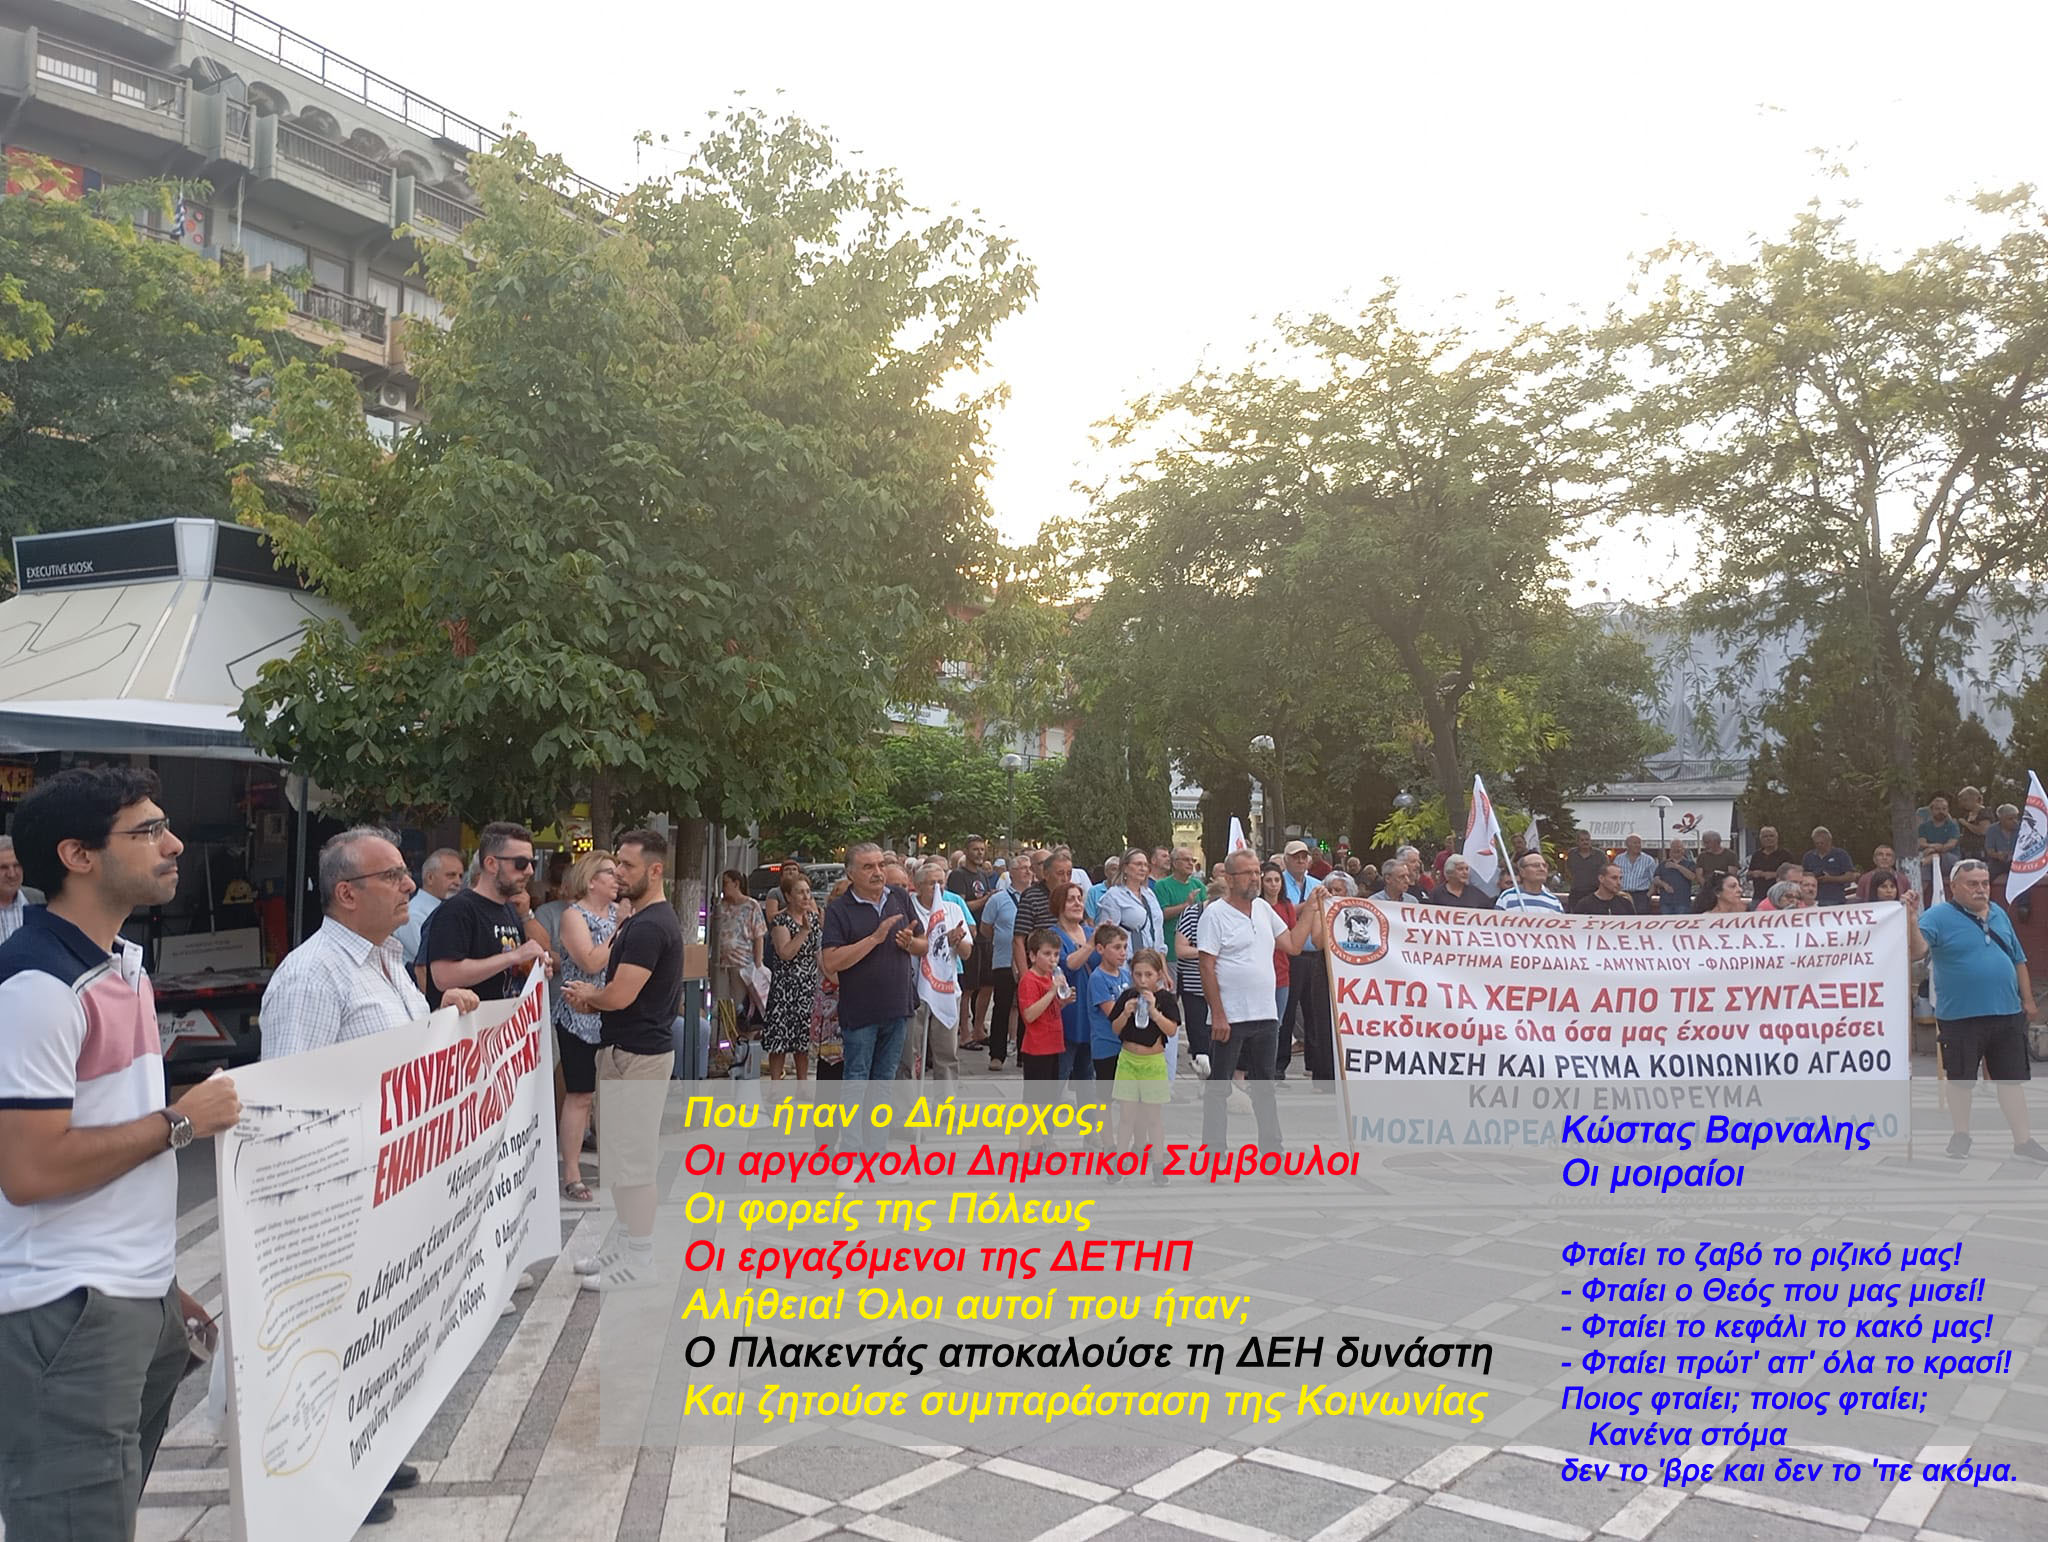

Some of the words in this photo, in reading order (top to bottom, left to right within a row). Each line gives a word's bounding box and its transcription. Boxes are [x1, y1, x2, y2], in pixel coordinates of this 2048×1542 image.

[26, 563, 68, 578] EXECUTIVE
[68, 560, 94, 574] KIOSK
[1589, 821, 1635, 835] TRENDY'S
[1401, 906, 1577, 930] ΠΑΝΕΛΛΗΝΙΟΣ
[1584, 917, 1706, 931] ΣΥΛΛΟΓΟΣ
[1708, 909, 1877, 930] ΑΛΛΗΛΕΓΓΥΗΣ
[1404, 928, 1577, 951] ΣΥΝΤΑΞΙΟΥΧΩΝ
[1402, 950, 1503, 969] ΠΑΡΑΡΤΗΜΑ
[1510, 956, 1590, 971] ΕΟΡΔΑΙΑΣ
[1337, 977, 1428, 1008] ΚΑΤΩ
[1438, 983, 1478, 1010] ΤΑ
[1485, 984, 1580, 1012] ΧΕΡΙΑ
[1591, 987, 1659, 1013] ΑΠΟ
[1670, 987, 1716, 1013] ΤΙΣ
[1725, 982, 1884, 1011] ΣΥΝΤΑΞΕΙΣ
[1338, 1012, 1508, 1046] Διεκδικούμε
[1515, 1020, 1555, 1043] όλα
[1565, 1020, 1612, 1043] όσα
[1622, 1024, 1668, 1047] μας
[1677, 1018, 1750, 1042] έχουν
[1758, 1015, 1885, 1044] αφαιρέσει
[1497, 1054, 1545, 1078] ΚΑΙ
[1555, 1054, 1640, 1079] ΡΕΥΜΑ
[1649, 1052, 1799, 1078] ΚΟΙΝΩΝΙΚΟ
[1808, 1049, 1892, 1075] ΑΓΑΘΟ
[1469, 1084, 1519, 1108] ΚΑΙ
[1533, 1086, 1580, 1109] ΟΧΙ
[1593, 1084, 1763, 1110] ΕΜΠΟΡΕΥΜΑ
[1463, 1118, 1560, 1145] ΔΩΡΕΑ
[373, 1106, 453, 1209] ΕΝΑΝΤΙΑ
[371, 1261, 407, 1307] Δήμοι
[407, 1242, 427, 1284] μας
